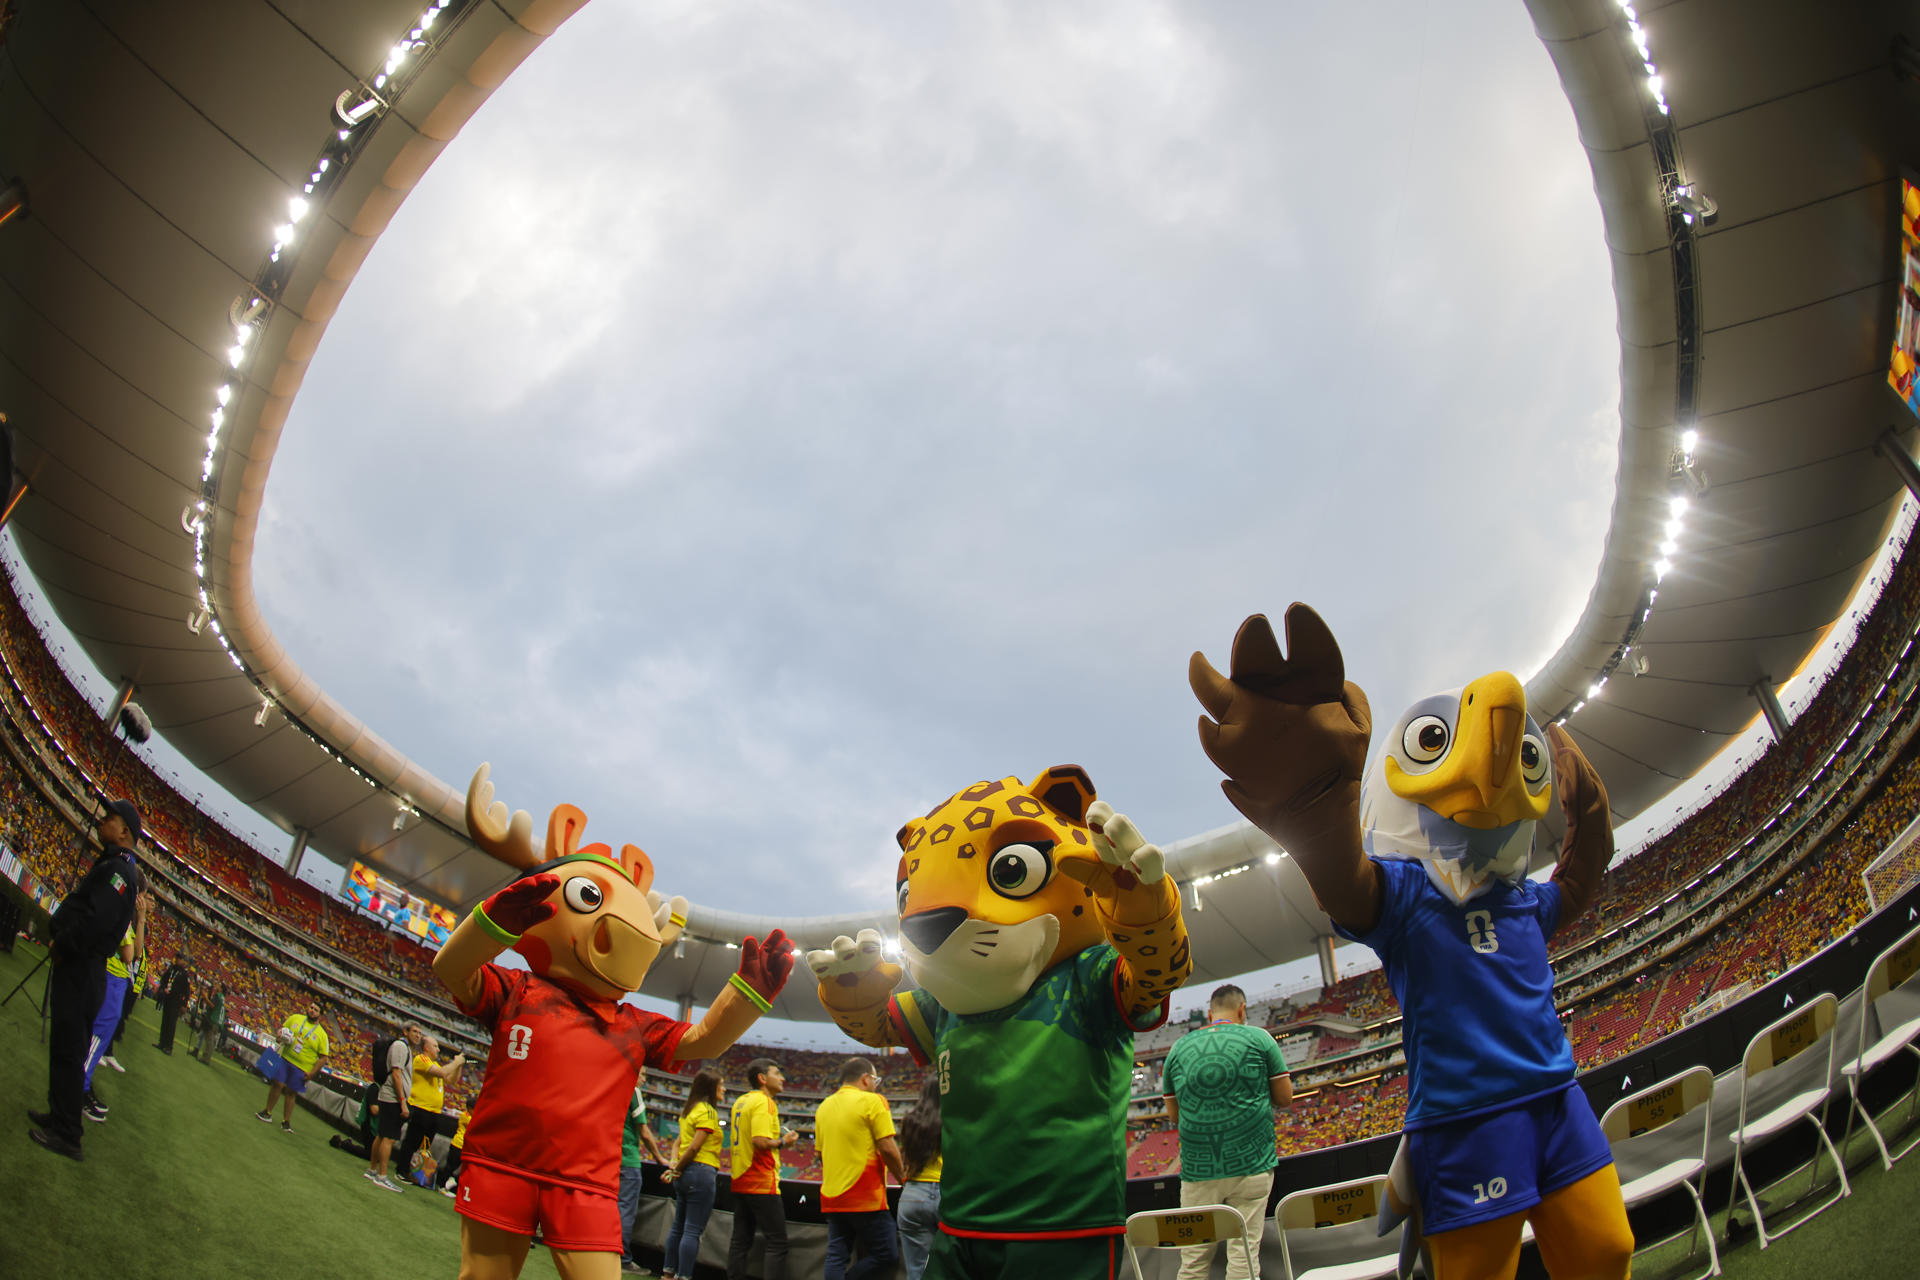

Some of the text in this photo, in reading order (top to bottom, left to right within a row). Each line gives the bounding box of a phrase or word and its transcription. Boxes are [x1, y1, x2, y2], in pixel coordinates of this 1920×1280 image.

[1779, 1015, 1809, 1038] Photo
[1637, 1086, 1675, 1110] Photo
[1650, 1104, 1665, 1121] 55
[463, 1186, 472, 1202] 1
[1323, 1188, 1365, 1204] Photo
[1473, 1176, 1508, 1205] 10
[1336, 1203, 1353, 1216] 57
[1165, 1214, 1204, 1225] Photo
[1178, 1227, 1193, 1238] 58
